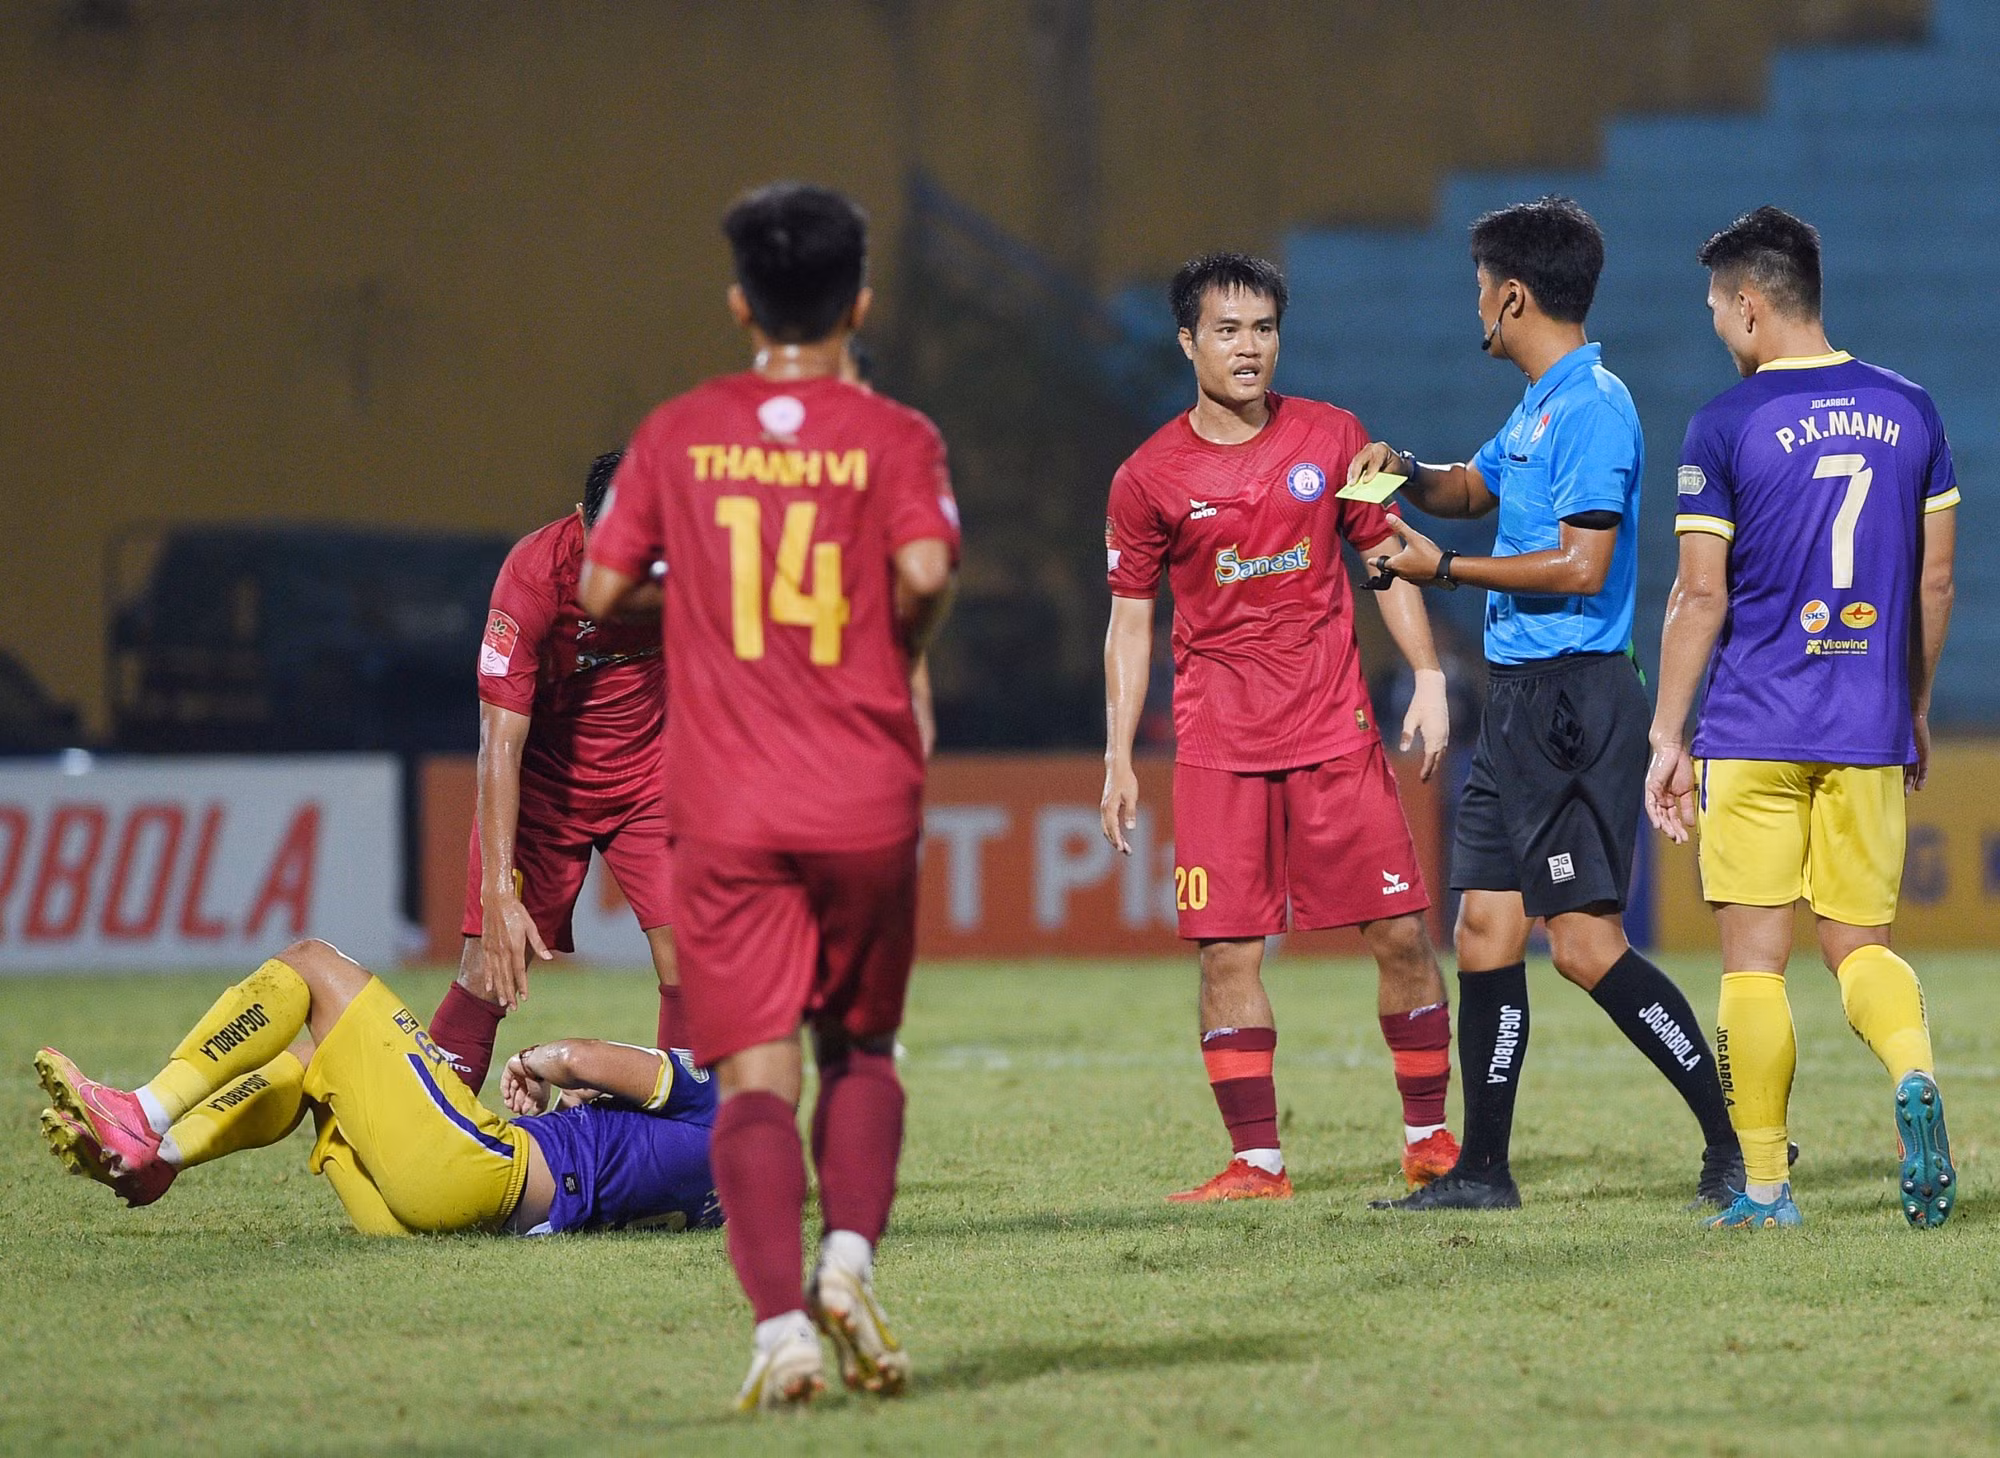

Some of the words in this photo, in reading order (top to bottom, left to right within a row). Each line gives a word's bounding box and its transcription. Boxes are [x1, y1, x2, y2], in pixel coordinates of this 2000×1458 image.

[1810, 397, 1856, 410] JOGARBOLA
[687, 443, 822, 487] THANH
[1811, 453, 1874, 590] 7
[715, 496, 850, 666] 14
[1215, 537, 1312, 588] Sanest
[1175, 866, 1208, 910] 20
[199, 1003, 271, 1062] JOGARBOLA
[1486, 1004, 1522, 1084] JOGARBOLA
[1638, 1001, 1702, 1072] JOGARBOLA
[206, 1073, 272, 1112] JOGARBOLA
[1716, 1025, 1737, 1108] JOGARBOLA
